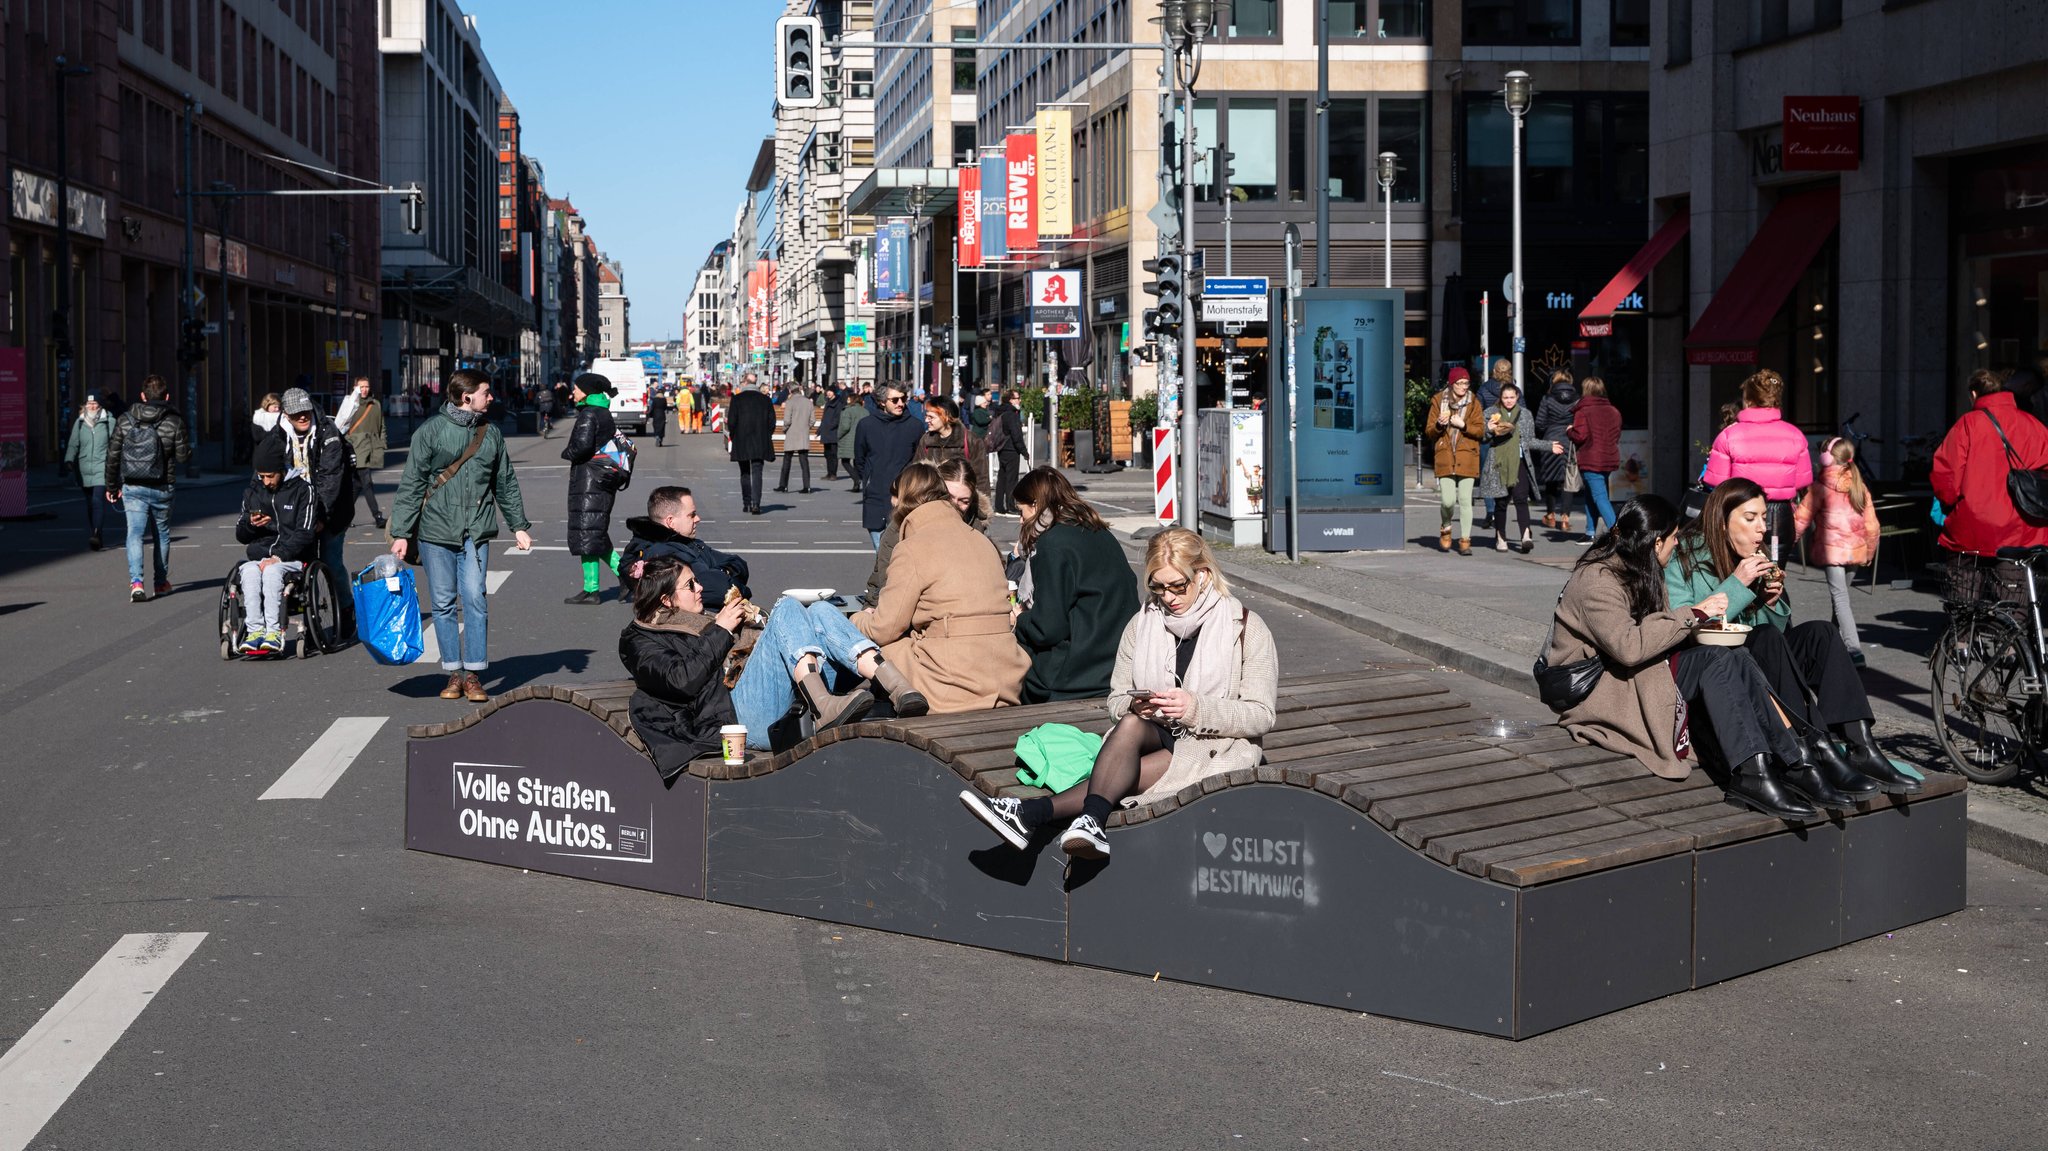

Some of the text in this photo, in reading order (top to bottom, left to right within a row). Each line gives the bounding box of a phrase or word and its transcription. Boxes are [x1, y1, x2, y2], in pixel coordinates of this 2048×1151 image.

[1789, 107, 1857, 123] Neuhaus
[1028, 154, 1036, 177] CITY
[1008, 160, 1028, 229] REWE
[983, 201, 1007, 212] 205
[1206, 304, 1263, 317] Mohrenstraße
[1333, 527, 1355, 536] Wall
[456, 771, 616, 814] Volle Straßen.
[459, 807, 613, 851] Ohne Autos.
[620, 829, 637, 838] BERLIN
[1230, 836, 1301, 866] SELBST
[1197, 866, 1305, 900] BESTIMMUNG
